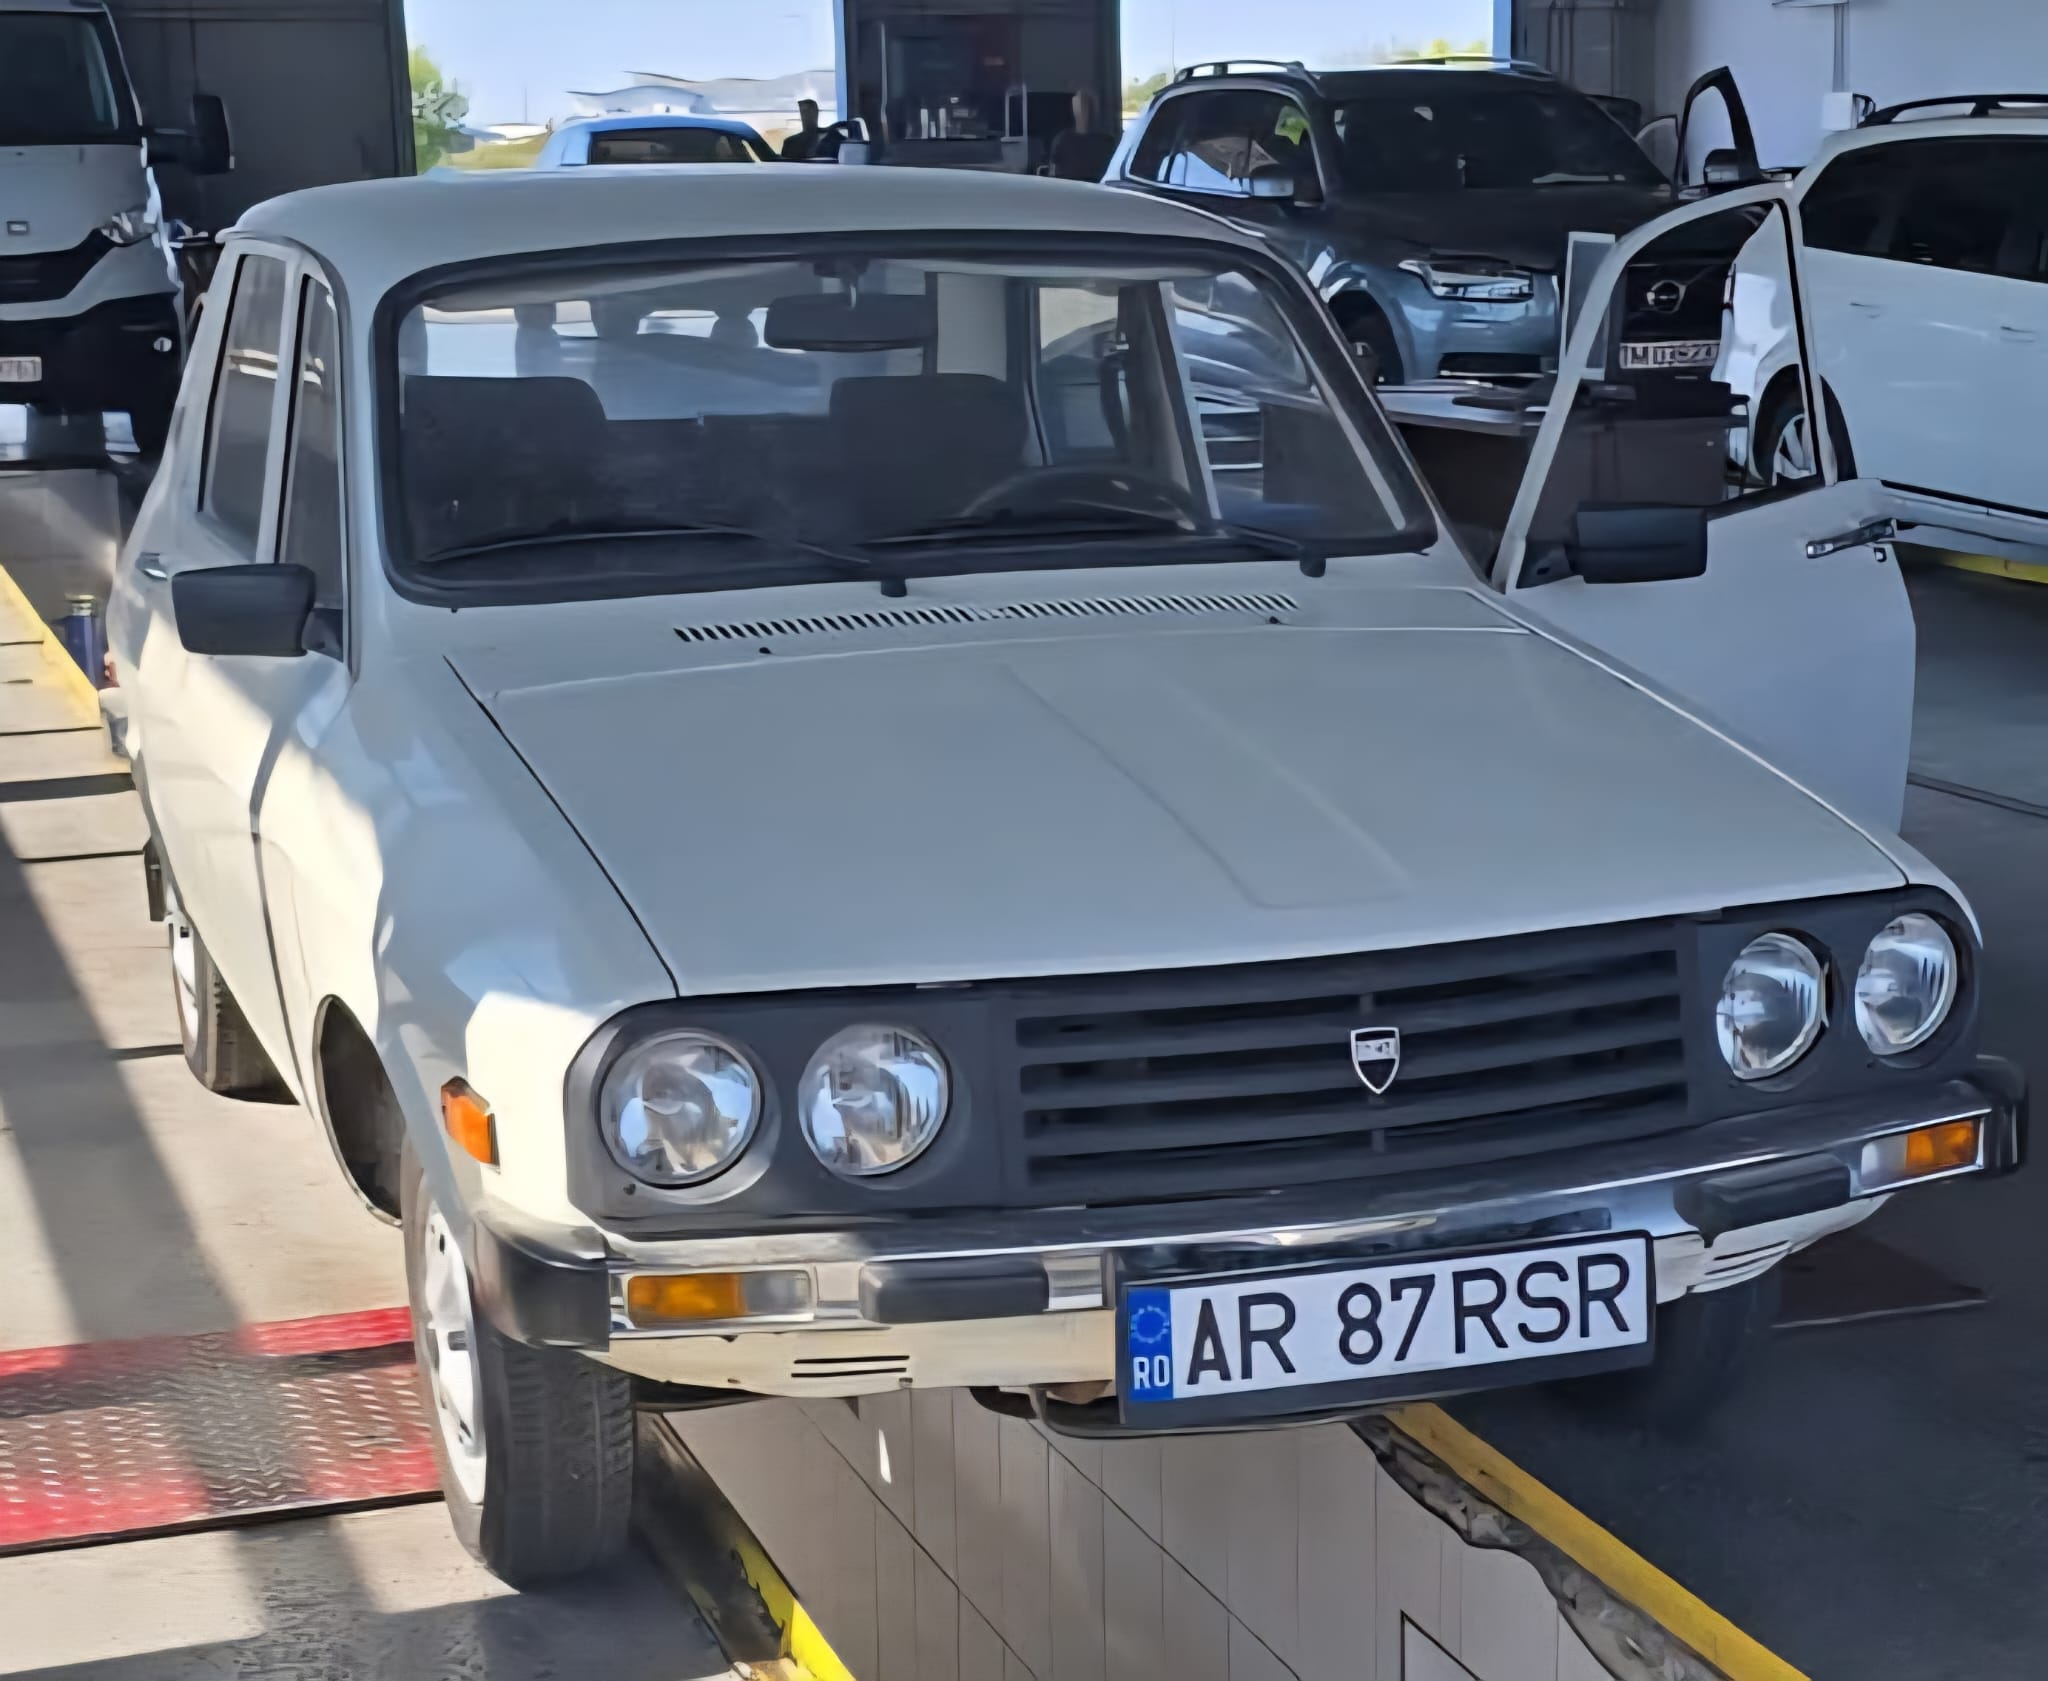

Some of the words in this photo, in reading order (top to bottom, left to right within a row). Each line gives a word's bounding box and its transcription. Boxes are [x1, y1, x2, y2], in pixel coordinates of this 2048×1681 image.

[1186, 1292, 1296, 1386] AR
[1337, 1273, 1436, 1365] 87
[1452, 1252, 1631, 1355] RSR
[1133, 1355, 1170, 1390] RO
